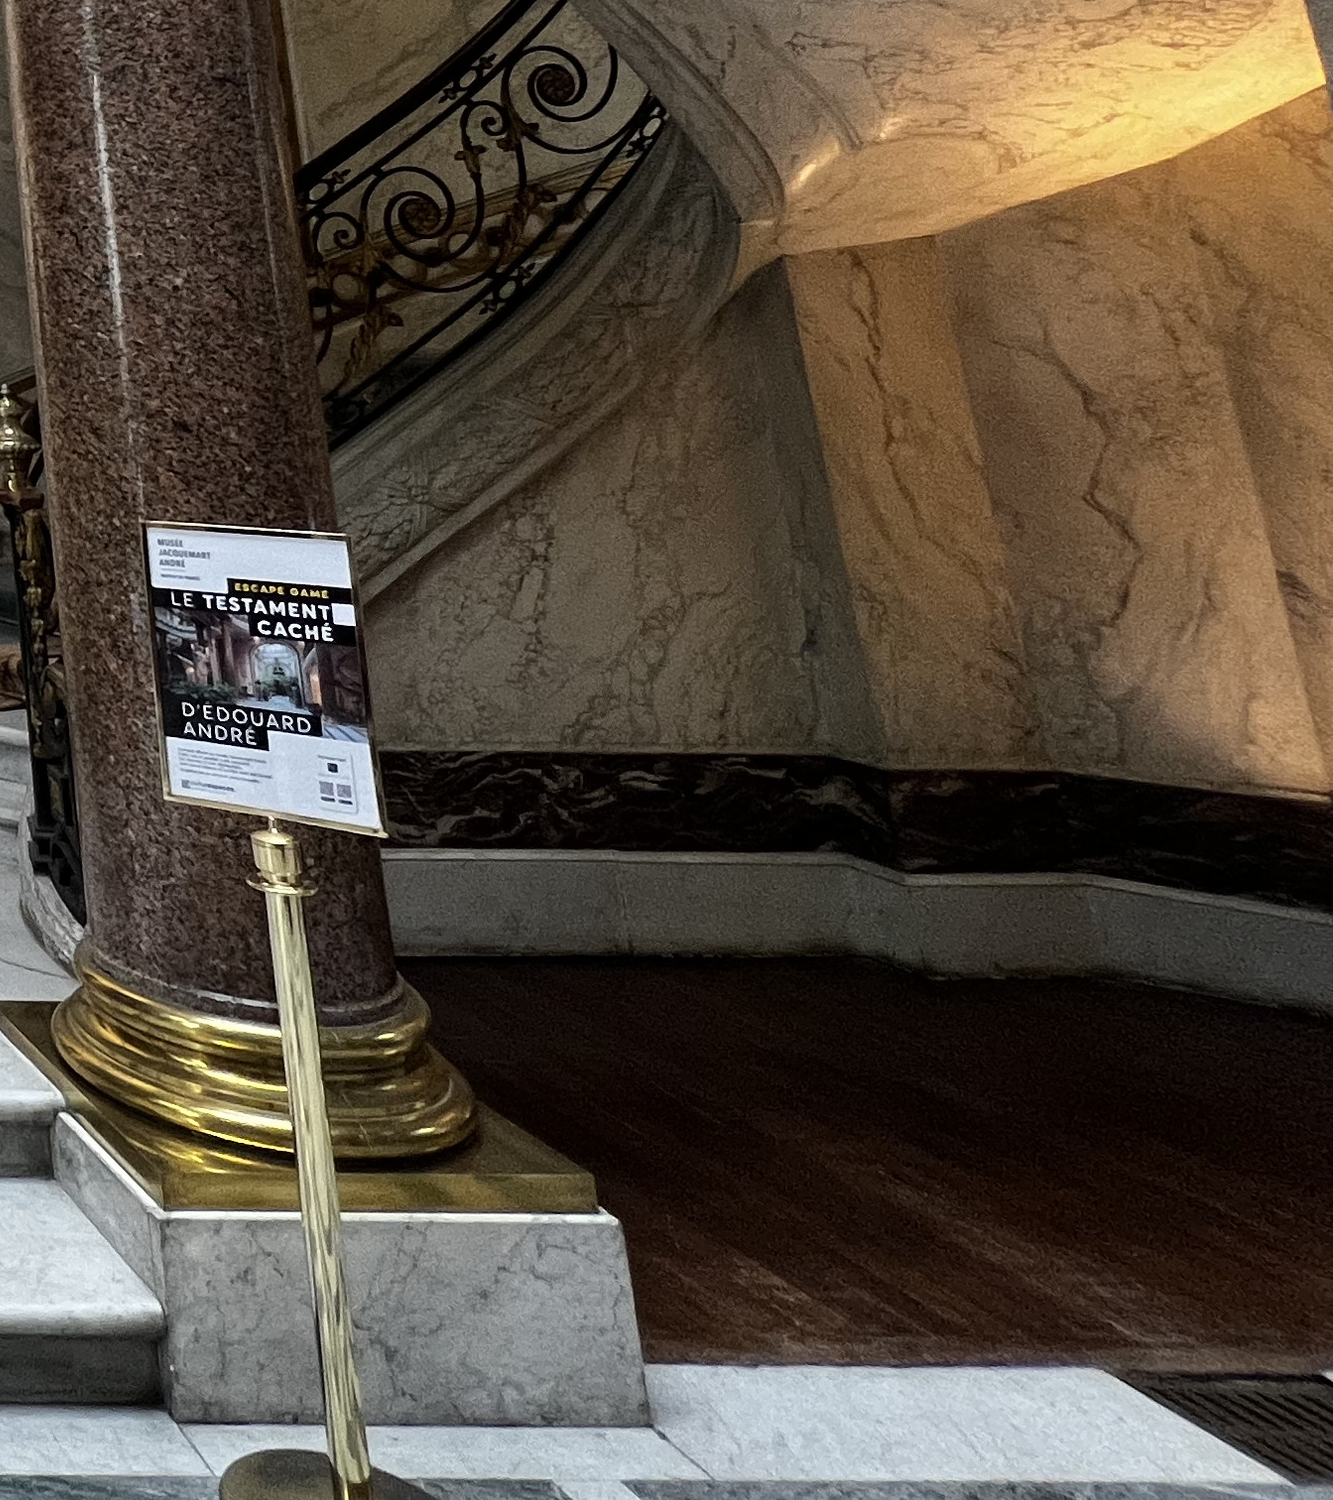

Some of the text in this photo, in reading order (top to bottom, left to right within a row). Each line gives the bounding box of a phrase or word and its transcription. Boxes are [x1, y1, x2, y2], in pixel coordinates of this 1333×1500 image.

[157, 538, 183, 548] MUSÉE
[158, 548, 211, 560] JACQUEMART
[159, 558, 186, 568] ANDRÉ
[234, 582, 330, 599] ESCAPE GAME
[170, 591, 330, 620] LE TESTAMENT
[257, 620, 334, 642] CACHÉ
[181, 701, 312, 733] D'ÉDOUARD
[183, 721, 258, 746] ANDRÉ
